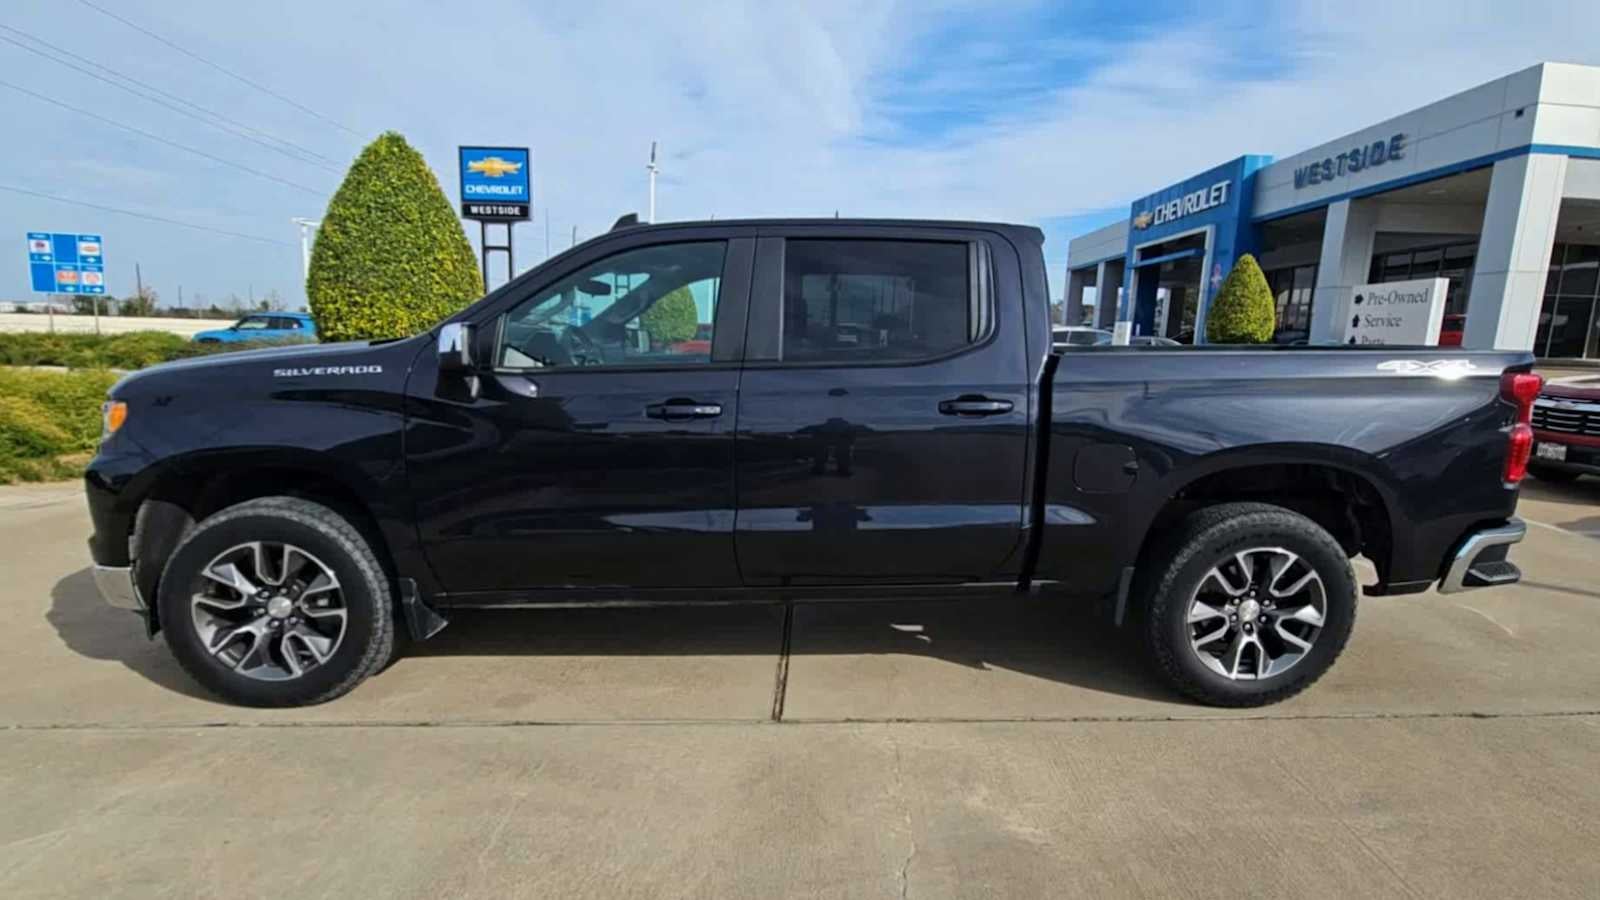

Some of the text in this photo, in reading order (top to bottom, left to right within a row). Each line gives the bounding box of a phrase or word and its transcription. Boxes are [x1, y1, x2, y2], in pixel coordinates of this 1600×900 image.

[1294, 133, 1407, 189] WESTSIDE
[465, 184, 524, 195] CHEVROLET
[470, 205, 521, 216] WESTSIDE
[1153, 180, 1232, 226] CHEVROLET
[1367, 288, 1429, 306] Pre-Owned
[1364, 313, 1402, 328] Service
[273, 365, 383, 377] SILVERADO
